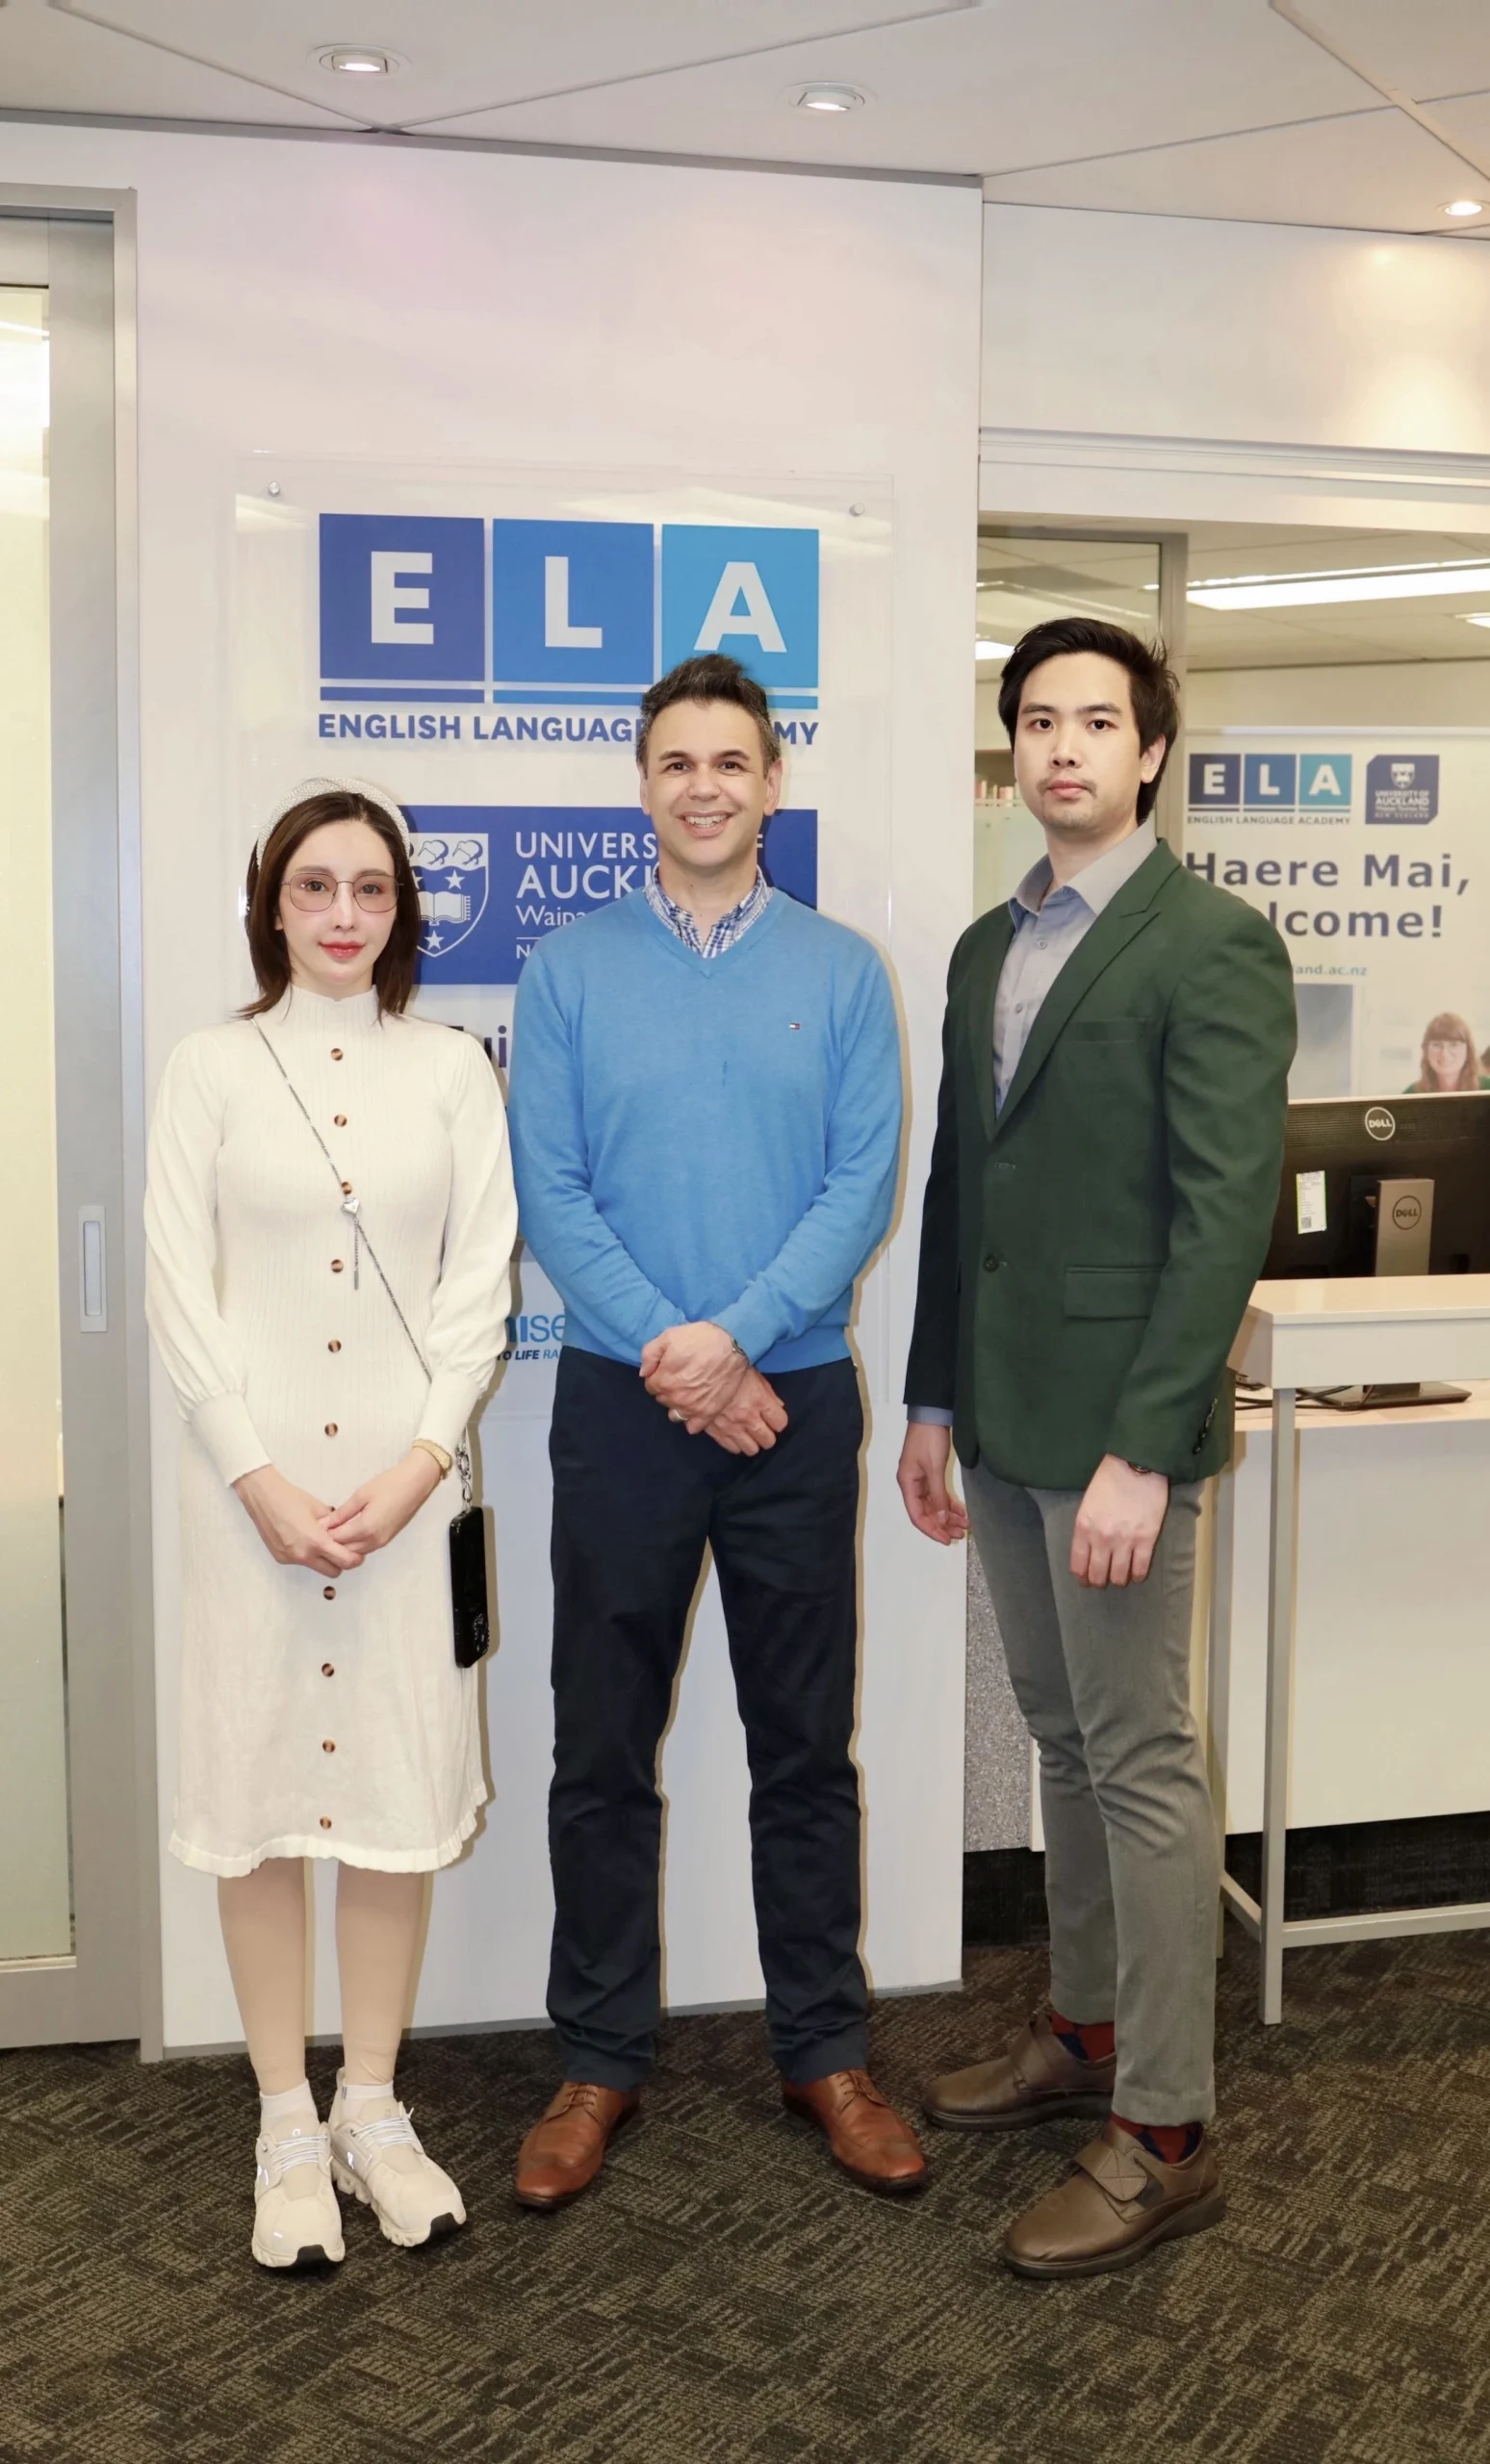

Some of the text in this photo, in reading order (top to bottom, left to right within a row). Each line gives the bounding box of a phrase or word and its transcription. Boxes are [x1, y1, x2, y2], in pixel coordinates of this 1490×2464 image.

[371, 551, 787, 653] ELA
[319, 713, 461, 739] ENGLISH
[1203, 763, 1342, 797] ELA
[1187, 815, 1351, 826] ENGLISH LANGUAGE ACADEMY
[515, 832, 657, 860] UNIVERS
[516, 864, 652, 899] AUCK
[1186, 852, 1470, 896] Haere Mai,
[1268, 901, 1443, 938] lcome!
[1368, 1118, 1392, 1128] DELL
[1396, 1208, 1419, 1218] DELL
[515, 1349, 540, 1361] LIFE
